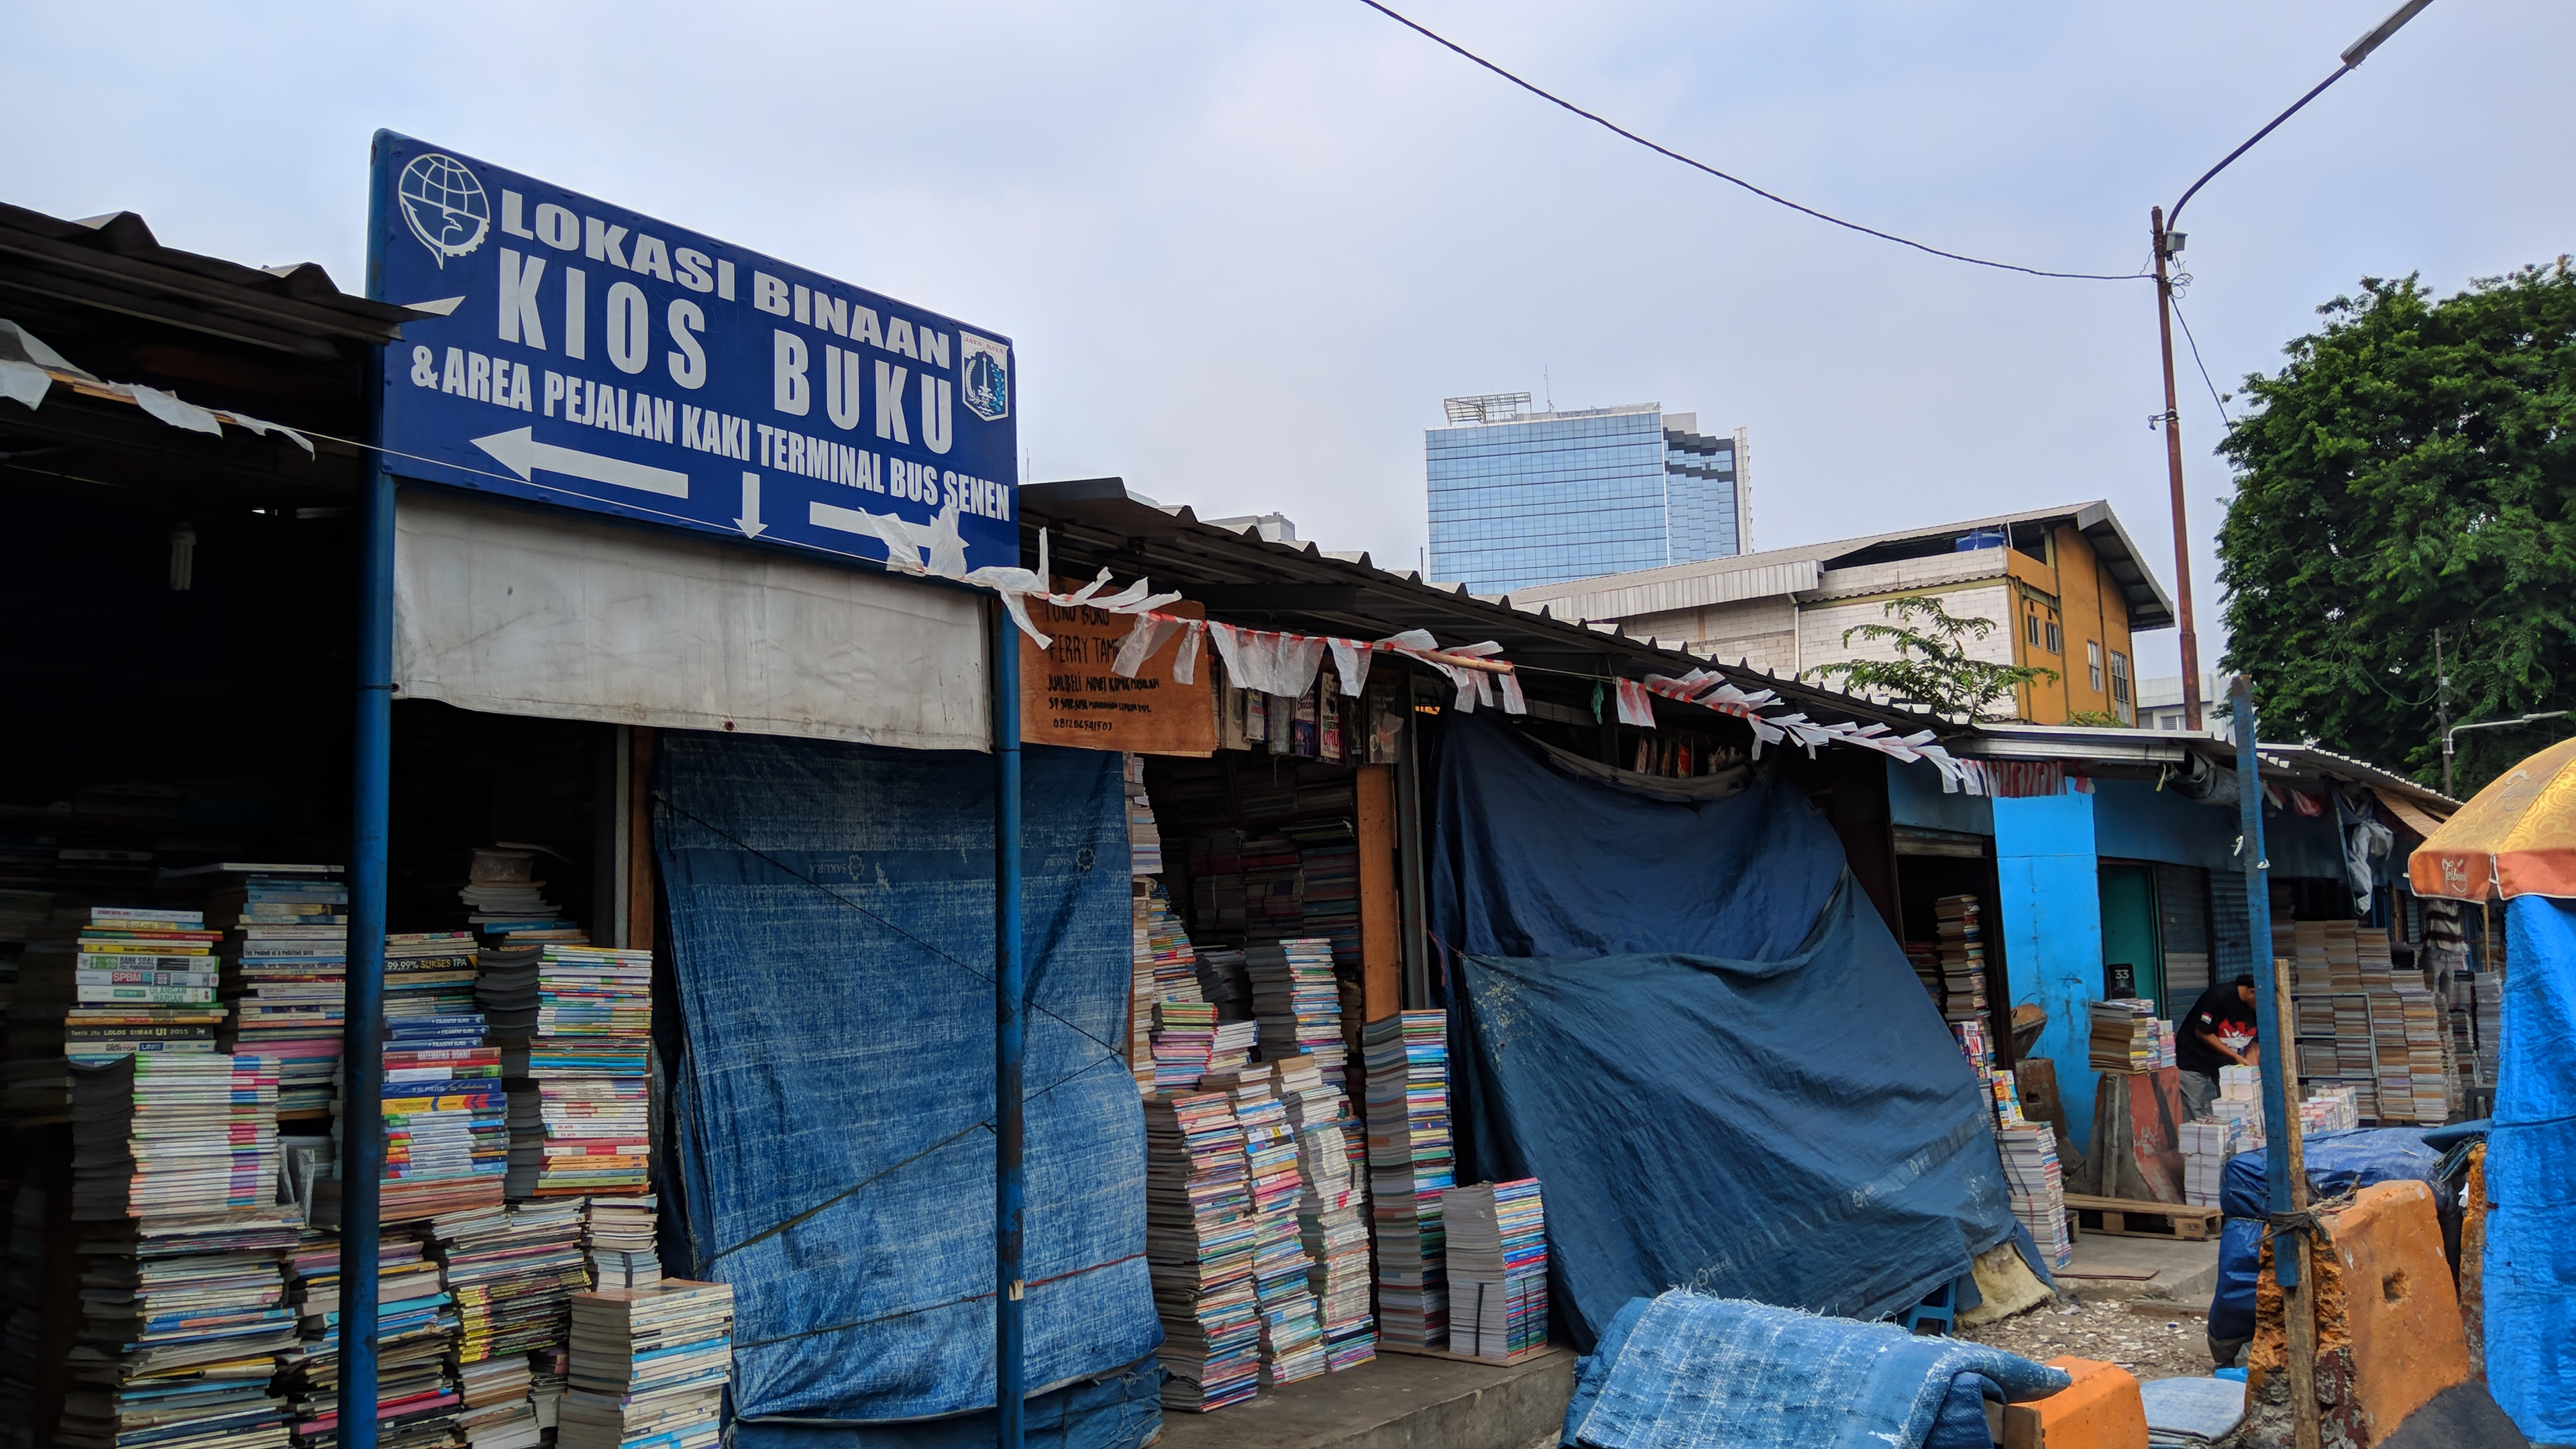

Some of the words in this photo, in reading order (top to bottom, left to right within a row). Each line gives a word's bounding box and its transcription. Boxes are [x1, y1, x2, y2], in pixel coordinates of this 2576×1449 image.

[500, 189, 736, 302] LOKASI
[753, 269, 951, 370] BINAAN
[965, 337, 982, 347] JAYA
[986, 343, 1004, 354] RAYA
[498, 248, 706, 390] KIOS
[773, 328, 953, 455] BUKU
[411, 345, 439, 390] &
[443, 346, 533, 413] AREA
[543, 368, 674, 444] PEJALAN
[682, 407, 751, 462] KAKI
[757, 423, 886, 494] TERMINAL
[890, 457, 939, 506] BUS
[943, 472, 1011, 522] SENEN
[119, 956, 137, 965] BANK
[138, 957, 155, 965] SOAL
[421, 959, 451, 969] SUKSES
[453, 959, 468, 967] TPA
[113, 973, 142, 982] SPBM
[2114, 969, 2130, 980] 33
[150, 986, 186, 995] ULANGAN
[154, 994, 183, 1002] HARIAN
[156, 1028, 167, 1036] UI
[417, 1051, 449, 1061] MATEMATIKA
[451, 1050, 471, 1059] DISKRIT
